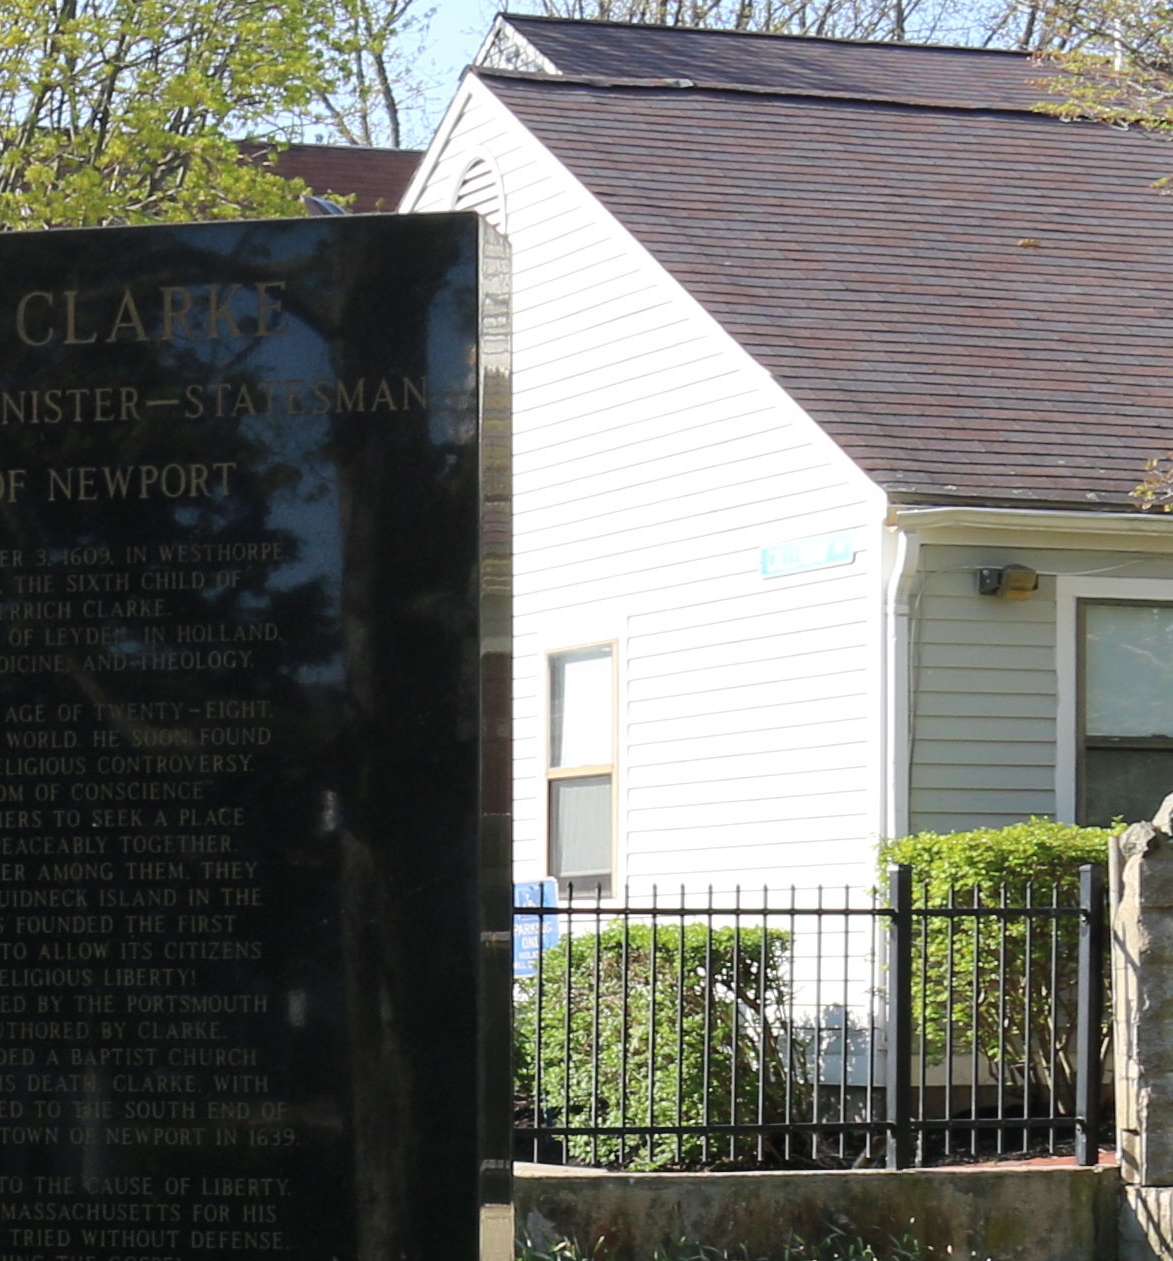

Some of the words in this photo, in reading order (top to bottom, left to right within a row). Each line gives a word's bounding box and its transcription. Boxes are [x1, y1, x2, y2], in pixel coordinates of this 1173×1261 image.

[16, 280, 289, 346] CLARKE
[48, 462, 237, 501] NEWPORT
[65, 573, 129, 594] SIXTH
[140, 571, 205, 592] CHILD
[199, 727, 271, 747] FOUND
[91, 809, 142, 829] SEEK
[179, 807, 245, 828] PLACE
[37, 863, 113, 882] AMONG
[199, 861, 258, 881] THEY
[99, 888, 176, 908] ISLAND
[16, 915, 113, 934] FOUNDED
[177, 914, 237, 933] FIRST
[38, 942, 109, 961] ALLOW
[163, 940, 262, 960] CITIZENS
[127, 994, 267, 1014] PORTSMOUTH
[71, 1048, 157, 1067] BAPTIST
[167, 1048, 257, 1067] CHURCH
[213, 1075, 269, 1093] WITH
[124, 1101, 195, 1120] SOUTH
[105, 1127, 205, 1146] NEWPORT
[1, 1202, 180, 1222] MASSACHUSETTS
[12, 1229, 70, 1248] TRIED
[81, 1230, 179, 1249] WITHOUT
